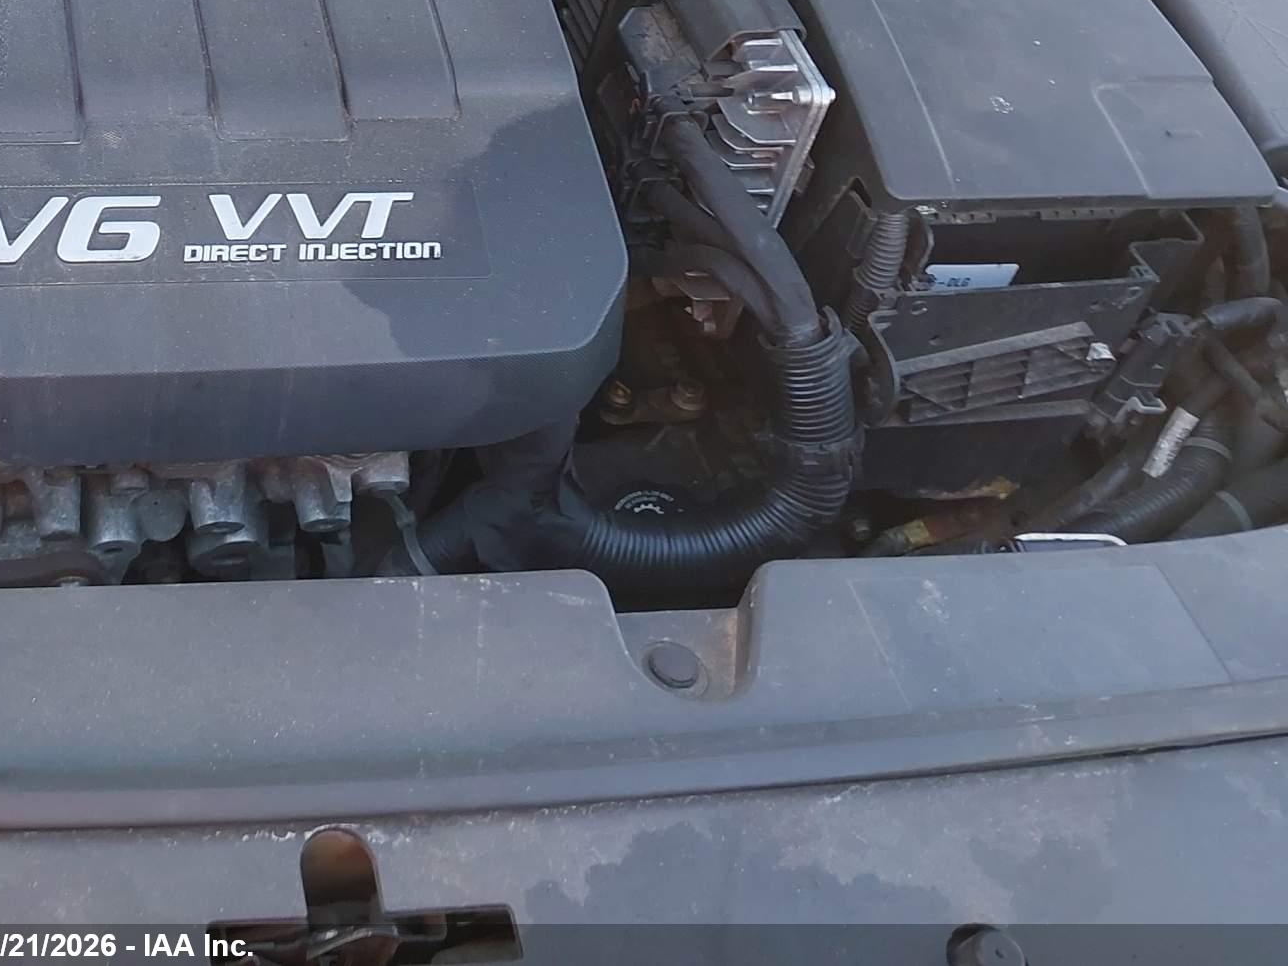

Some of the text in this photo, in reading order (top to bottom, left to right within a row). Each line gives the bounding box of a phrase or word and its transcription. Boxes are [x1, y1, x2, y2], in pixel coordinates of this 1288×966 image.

[208, 192, 414, 240] VVT
[183, 242, 442, 263] DIRECT INJECTION
